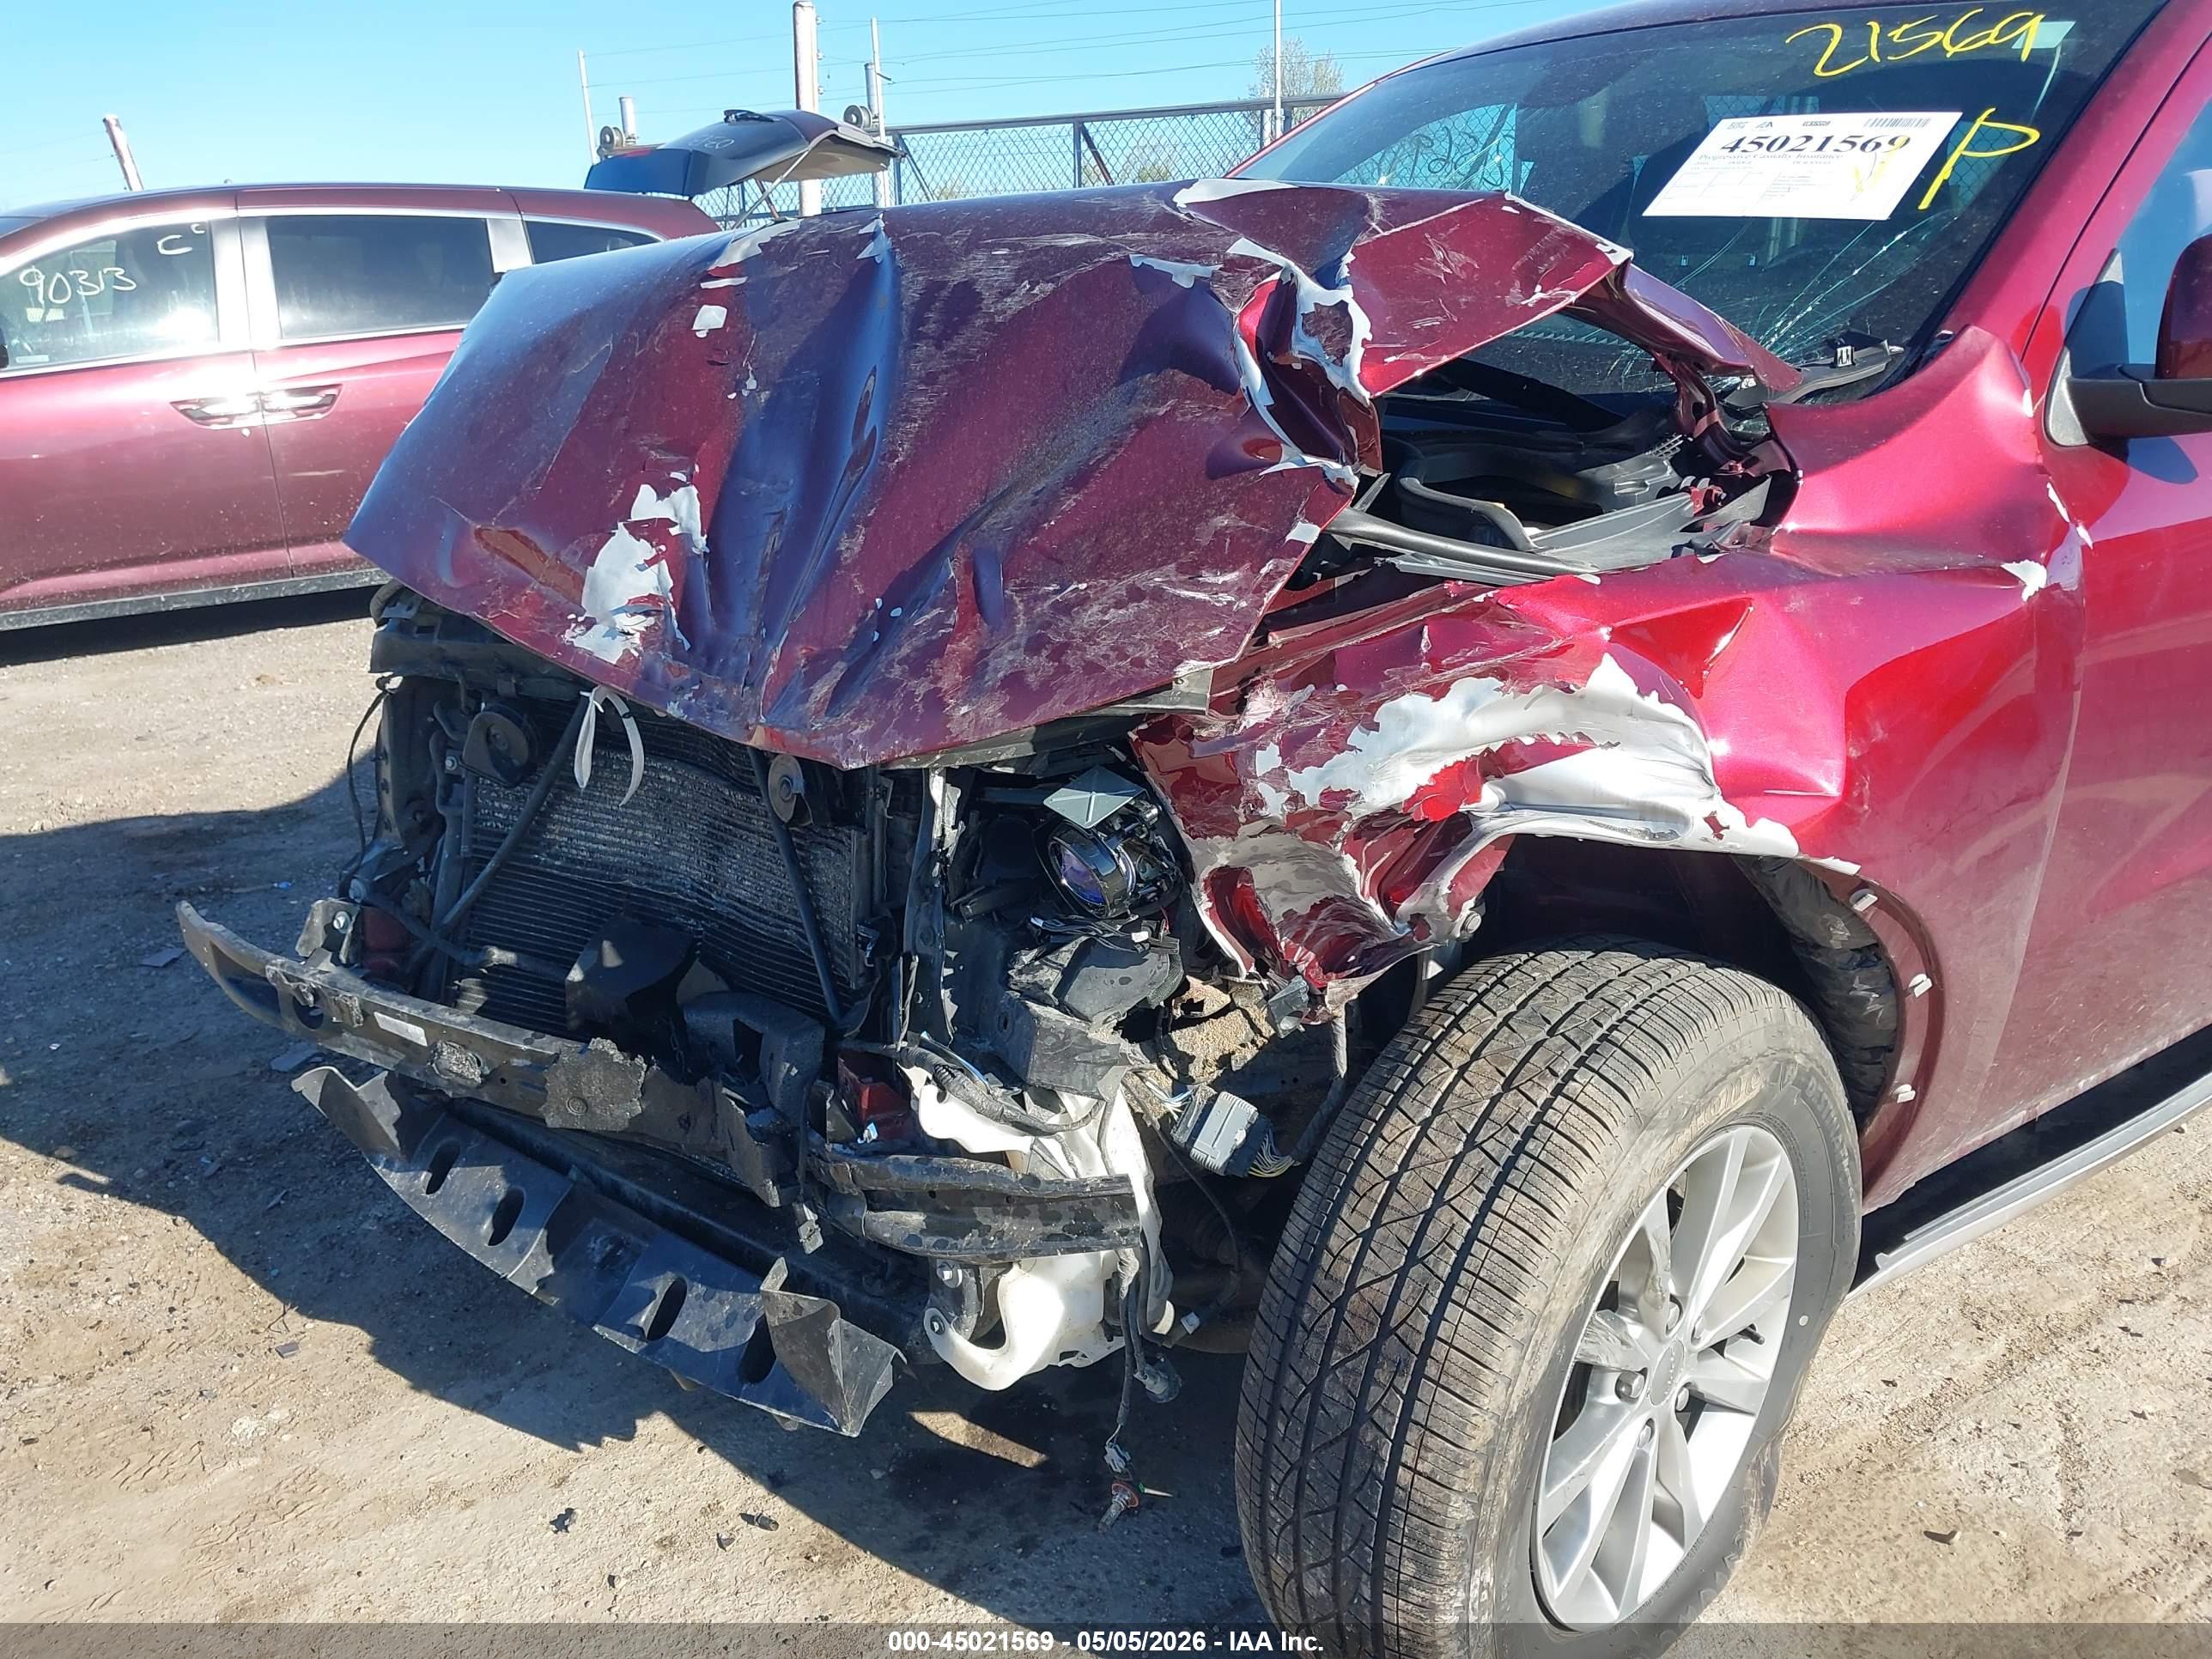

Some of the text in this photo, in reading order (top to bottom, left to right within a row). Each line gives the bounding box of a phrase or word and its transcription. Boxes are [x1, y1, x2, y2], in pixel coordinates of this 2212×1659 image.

[1785, 8, 2046, 76] 21569
[1720, 135, 1911, 153] 45021569
[1917, 108, 2041, 211] P
[19, 266, 137, 304] 90313
